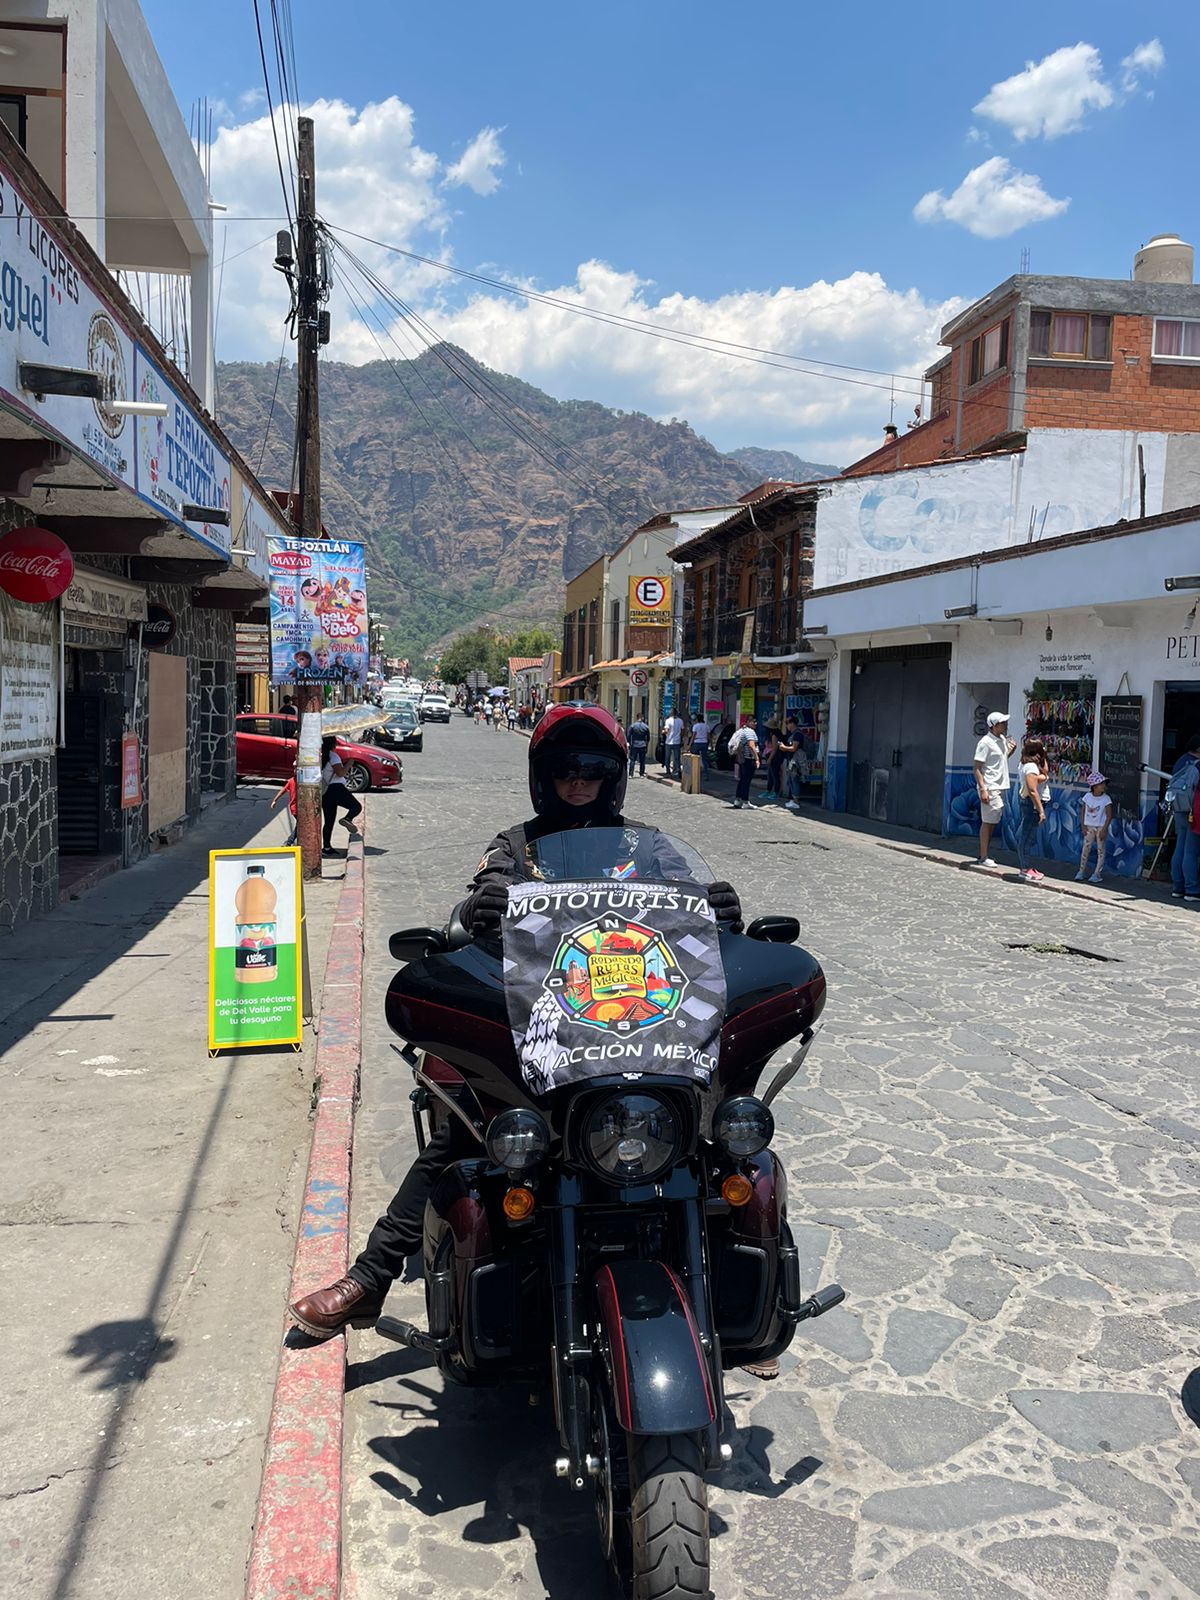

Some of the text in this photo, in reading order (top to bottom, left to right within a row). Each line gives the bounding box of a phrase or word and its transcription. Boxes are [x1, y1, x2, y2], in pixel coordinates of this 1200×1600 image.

[14, 193, 79, 304] Y LICORES
[0, 261, 49, 346] guel
[175, 403, 216, 480] FARMACIA
[284, 540, 350, 554] TEPOZTLÁN
[0, 551, 62, 578] Coca-Cola
[272, 556, 311, 566] MAYAR
[643, 582, 657, 602] E
[280, 595, 295, 606] 14
[297, 667, 343, 679] FROZEN
[506, 890, 710, 918] MOTOTURISTA
[604, 919, 620, 928] N
[215, 996, 296, 1007] Deliciosos néctares
[232, 1007, 247, 1015] Del
[249, 1006, 271, 1014] Valle
[272, 1005, 292, 1014] para
[230, 1015, 282, 1025] tu desayuno
[553, 1041, 643, 1069] ACCIÓN
[653, 1041, 717, 1071] MÉXICO
